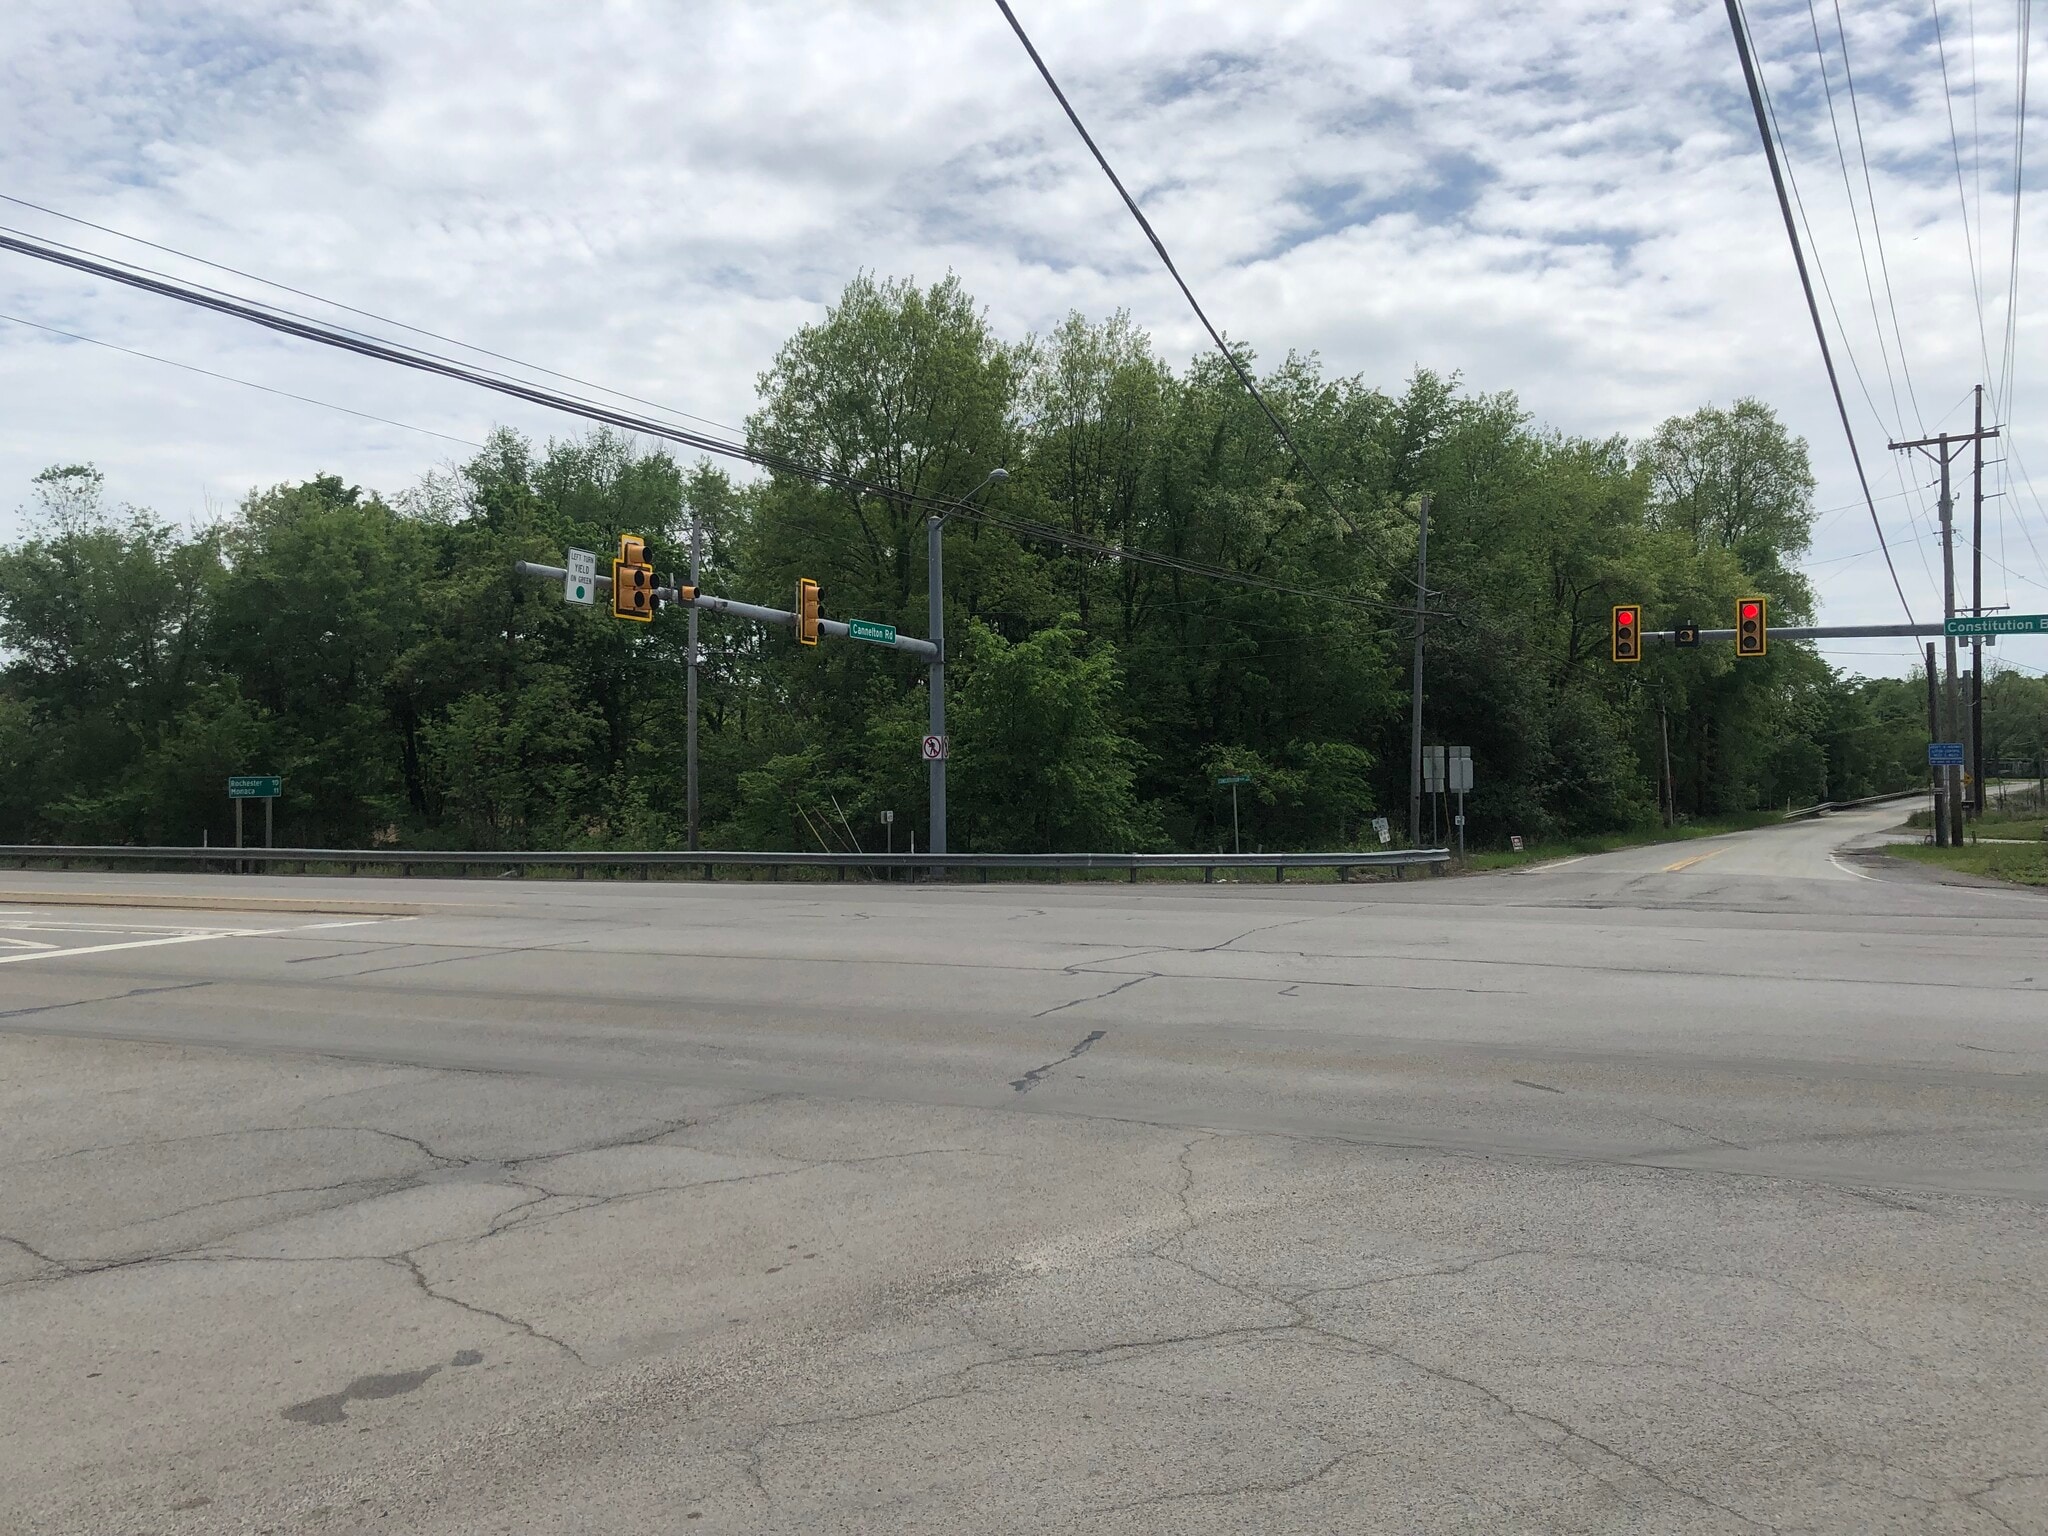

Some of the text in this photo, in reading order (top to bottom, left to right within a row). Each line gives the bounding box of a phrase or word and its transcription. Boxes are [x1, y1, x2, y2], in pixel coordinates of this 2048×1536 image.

[571, 551, 593, 563] LEFT TURN
[575, 563, 589, 574] YIELD
[578, 576, 591, 584] GREEN
[853, 623, 893, 640] Cannelton Rd
[1948, 620, 2033, 632] Constitution
